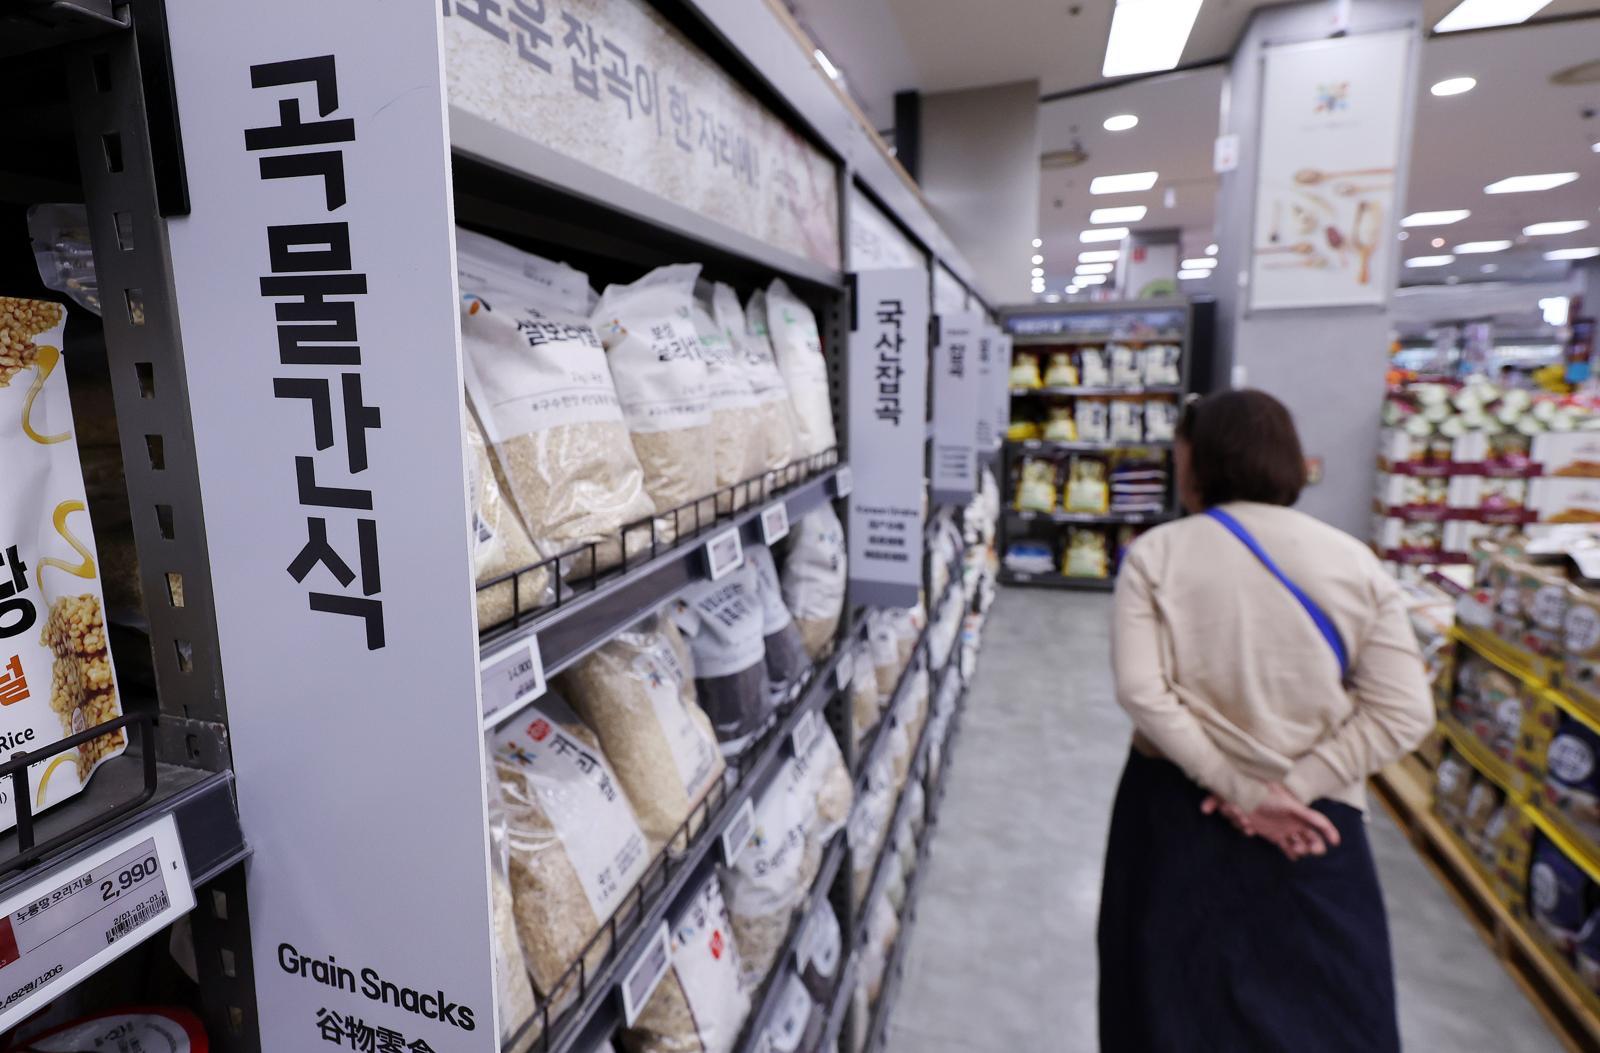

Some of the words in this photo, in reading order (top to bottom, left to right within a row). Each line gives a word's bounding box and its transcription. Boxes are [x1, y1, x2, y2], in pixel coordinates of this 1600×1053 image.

[559, 10, 662, 137] 잡곡이
[667, 85, 692, 152] 한
[244, 54, 386, 651] 곡물간식
[874, 299, 907, 427] 국산잡곡
[52, 873, 94, 902] 오리지널
[100, 856, 158, 901] 2,990
[277, 942, 356, 993] Grain
[361, 967, 476, 1032] Snacks
